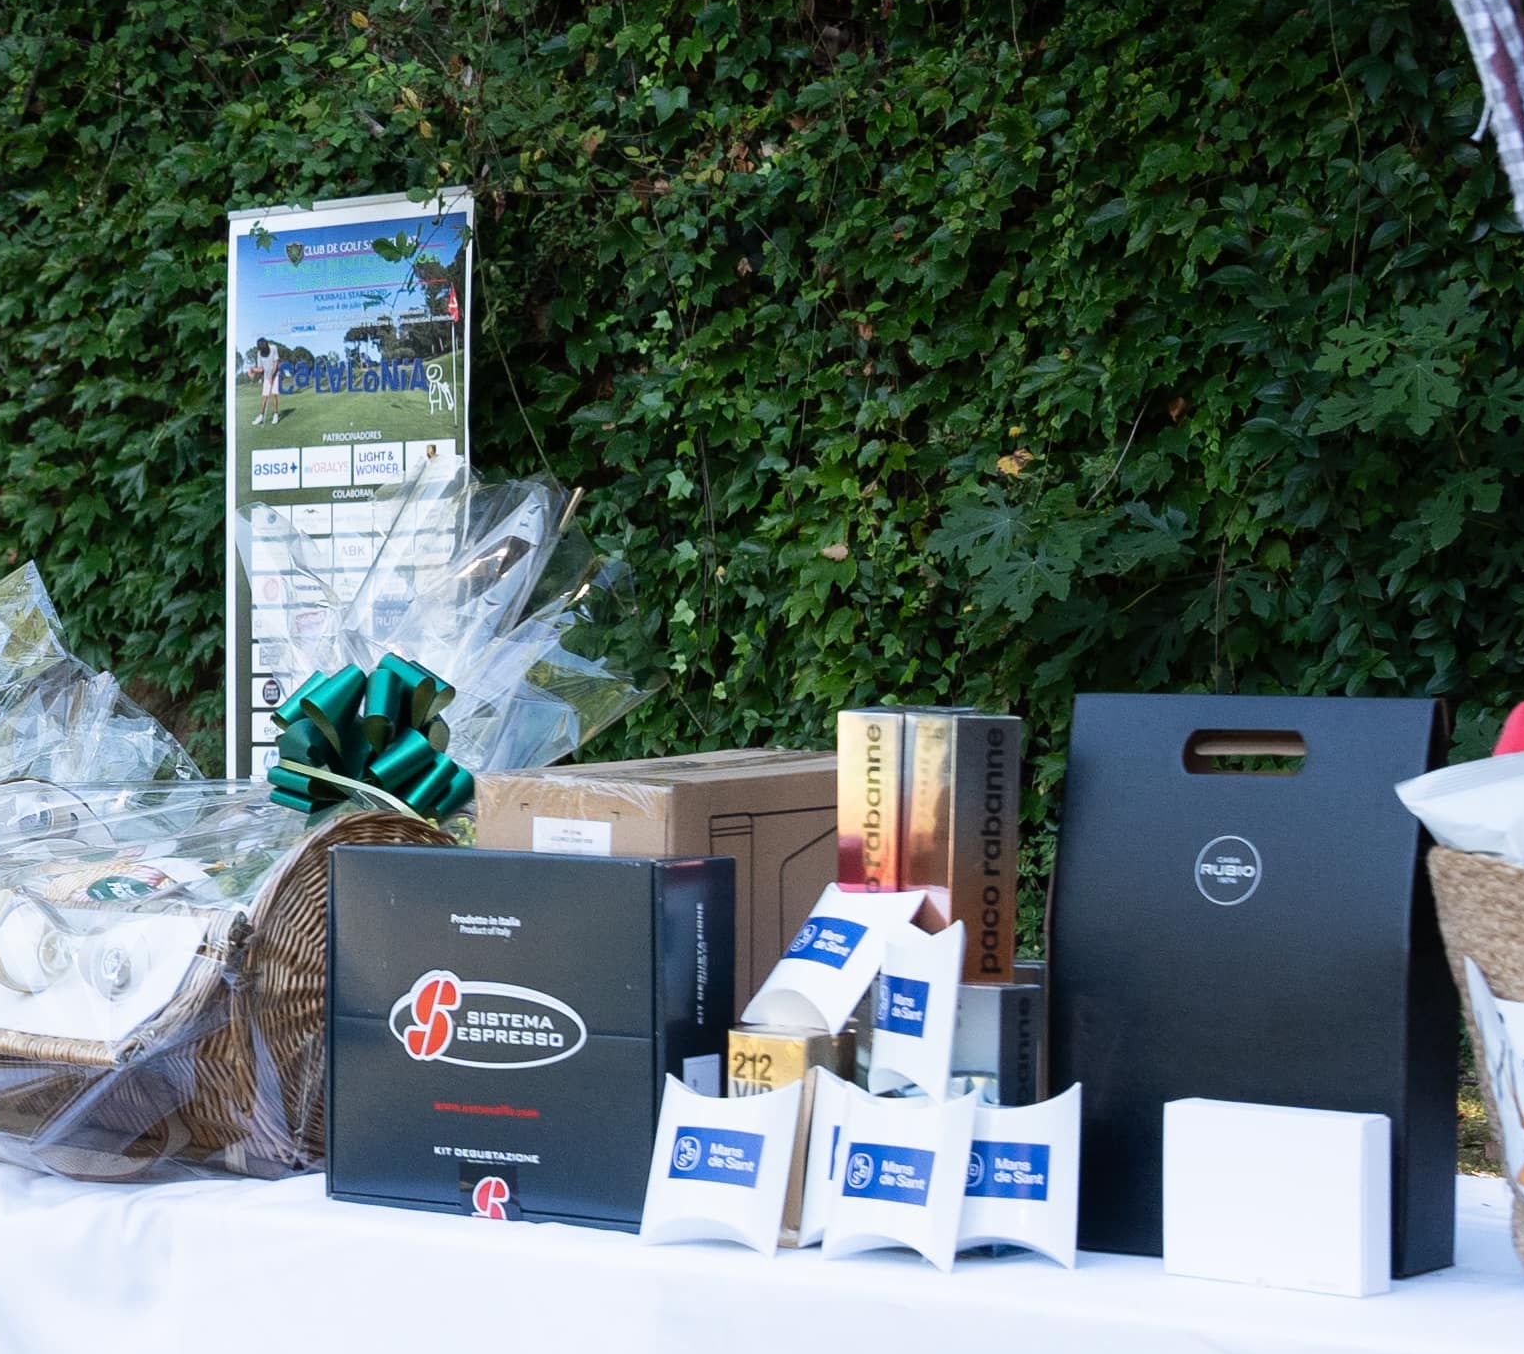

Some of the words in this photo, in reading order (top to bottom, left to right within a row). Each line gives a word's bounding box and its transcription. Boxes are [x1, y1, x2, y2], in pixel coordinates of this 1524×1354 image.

[304, 244, 326, 256] CLUB
[359, 451, 385, 463] LIGHT
[387, 451, 395, 461] &
[356, 462, 399, 476] WONDER
[862, 723, 883, 868] rabanne
[980, 726, 1006, 876] rabanne
[1199, 863, 1256, 877] RUBIO
[820, 929, 848, 945] Mans
[980, 885, 1002, 976] paco
[892, 992, 915, 1007] Mans
[467, 1011, 554, 1030] SISTEMA
[456, 1027, 564, 1047] ESPRESSO
[733, 1051, 773, 1081] 212
[433, 1146, 453, 1156] KIT
[453, 1147, 541, 1165] DEGUSTAZIONE
[709, 1142, 745, 1157] Mans
[707, 1154, 724, 1167] de
[725, 1157, 756, 1172] Sant
[881, 1159, 915, 1176] Mans
[994, 1156, 1031, 1172] Mans
[878, 1173, 896, 1186] de
[895, 1174, 926, 1190] Sant
[993, 1170, 1012, 1183] de
[1012, 1170, 1044, 1185] Sant
